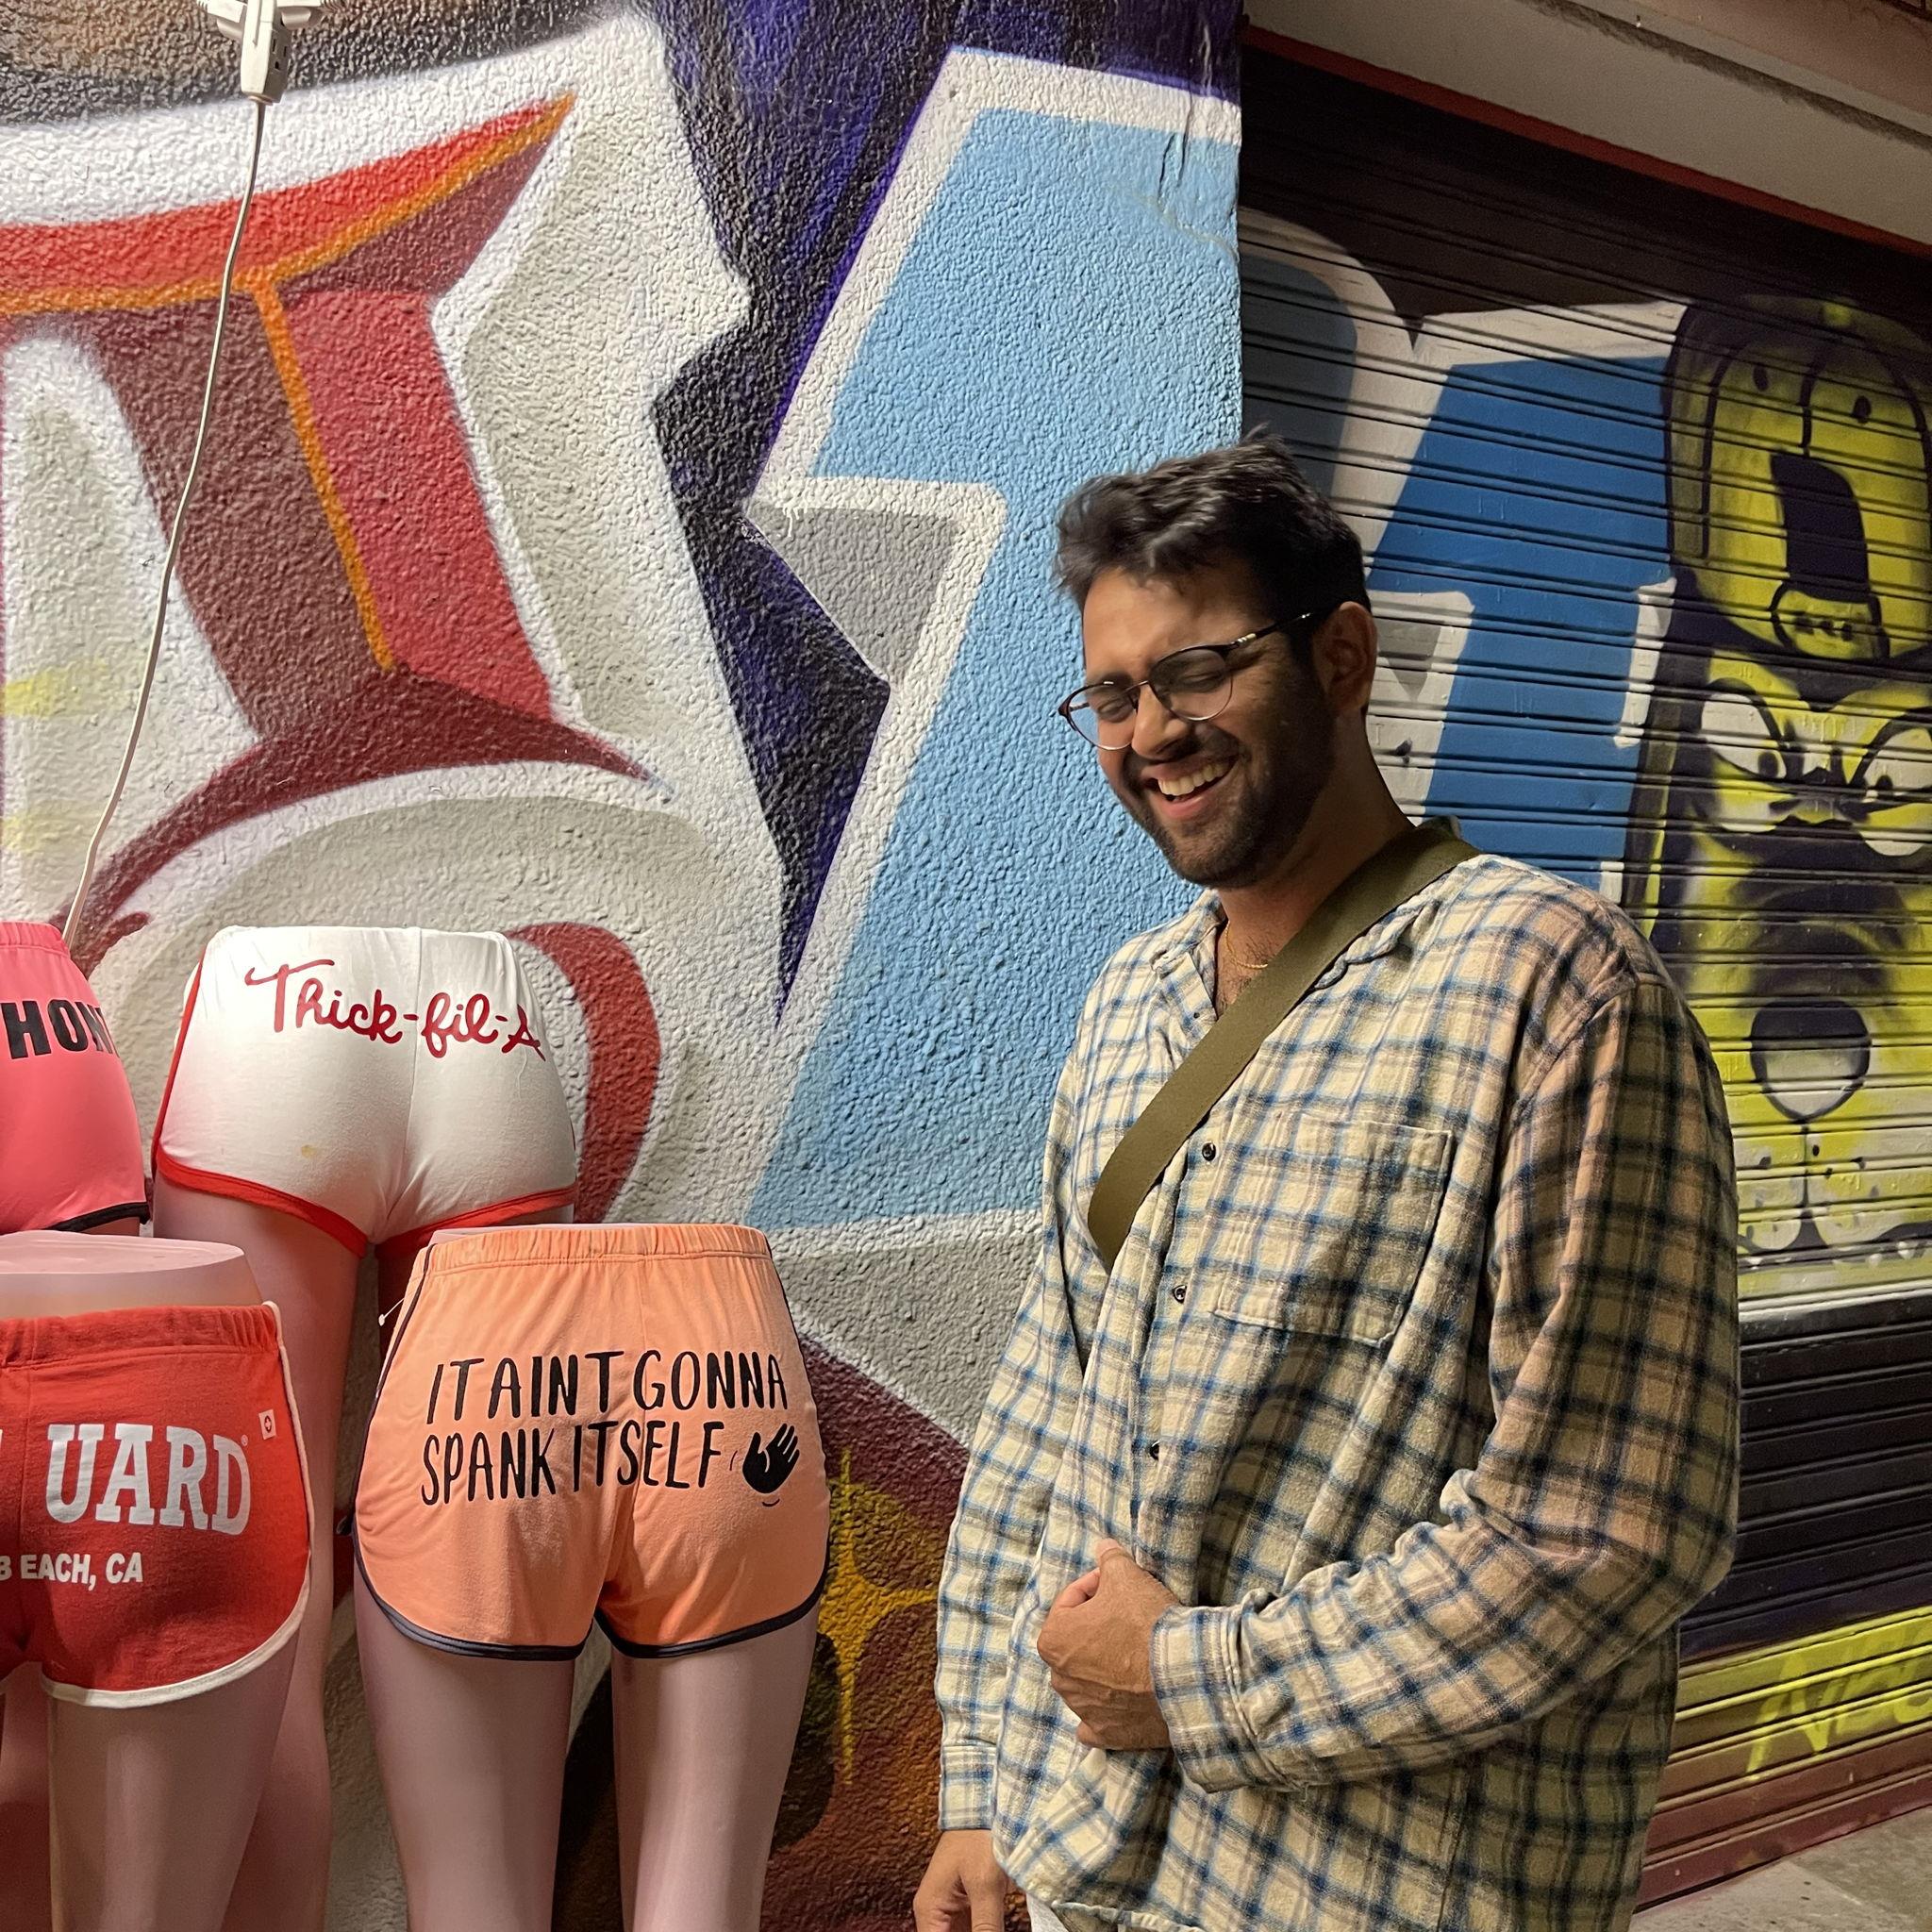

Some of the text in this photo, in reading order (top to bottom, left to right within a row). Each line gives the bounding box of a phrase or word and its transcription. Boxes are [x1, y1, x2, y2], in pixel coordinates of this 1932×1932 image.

[244, 958, 545, 1062] Thick-fil-A
[426, 1349, 788, 1424] IT AINT GONNA
[0, 1423, 251, 1536] UARD
[421, 1419, 724, 1506] SPANK ITSELF
[105, 1552, 143, 1584] CA
